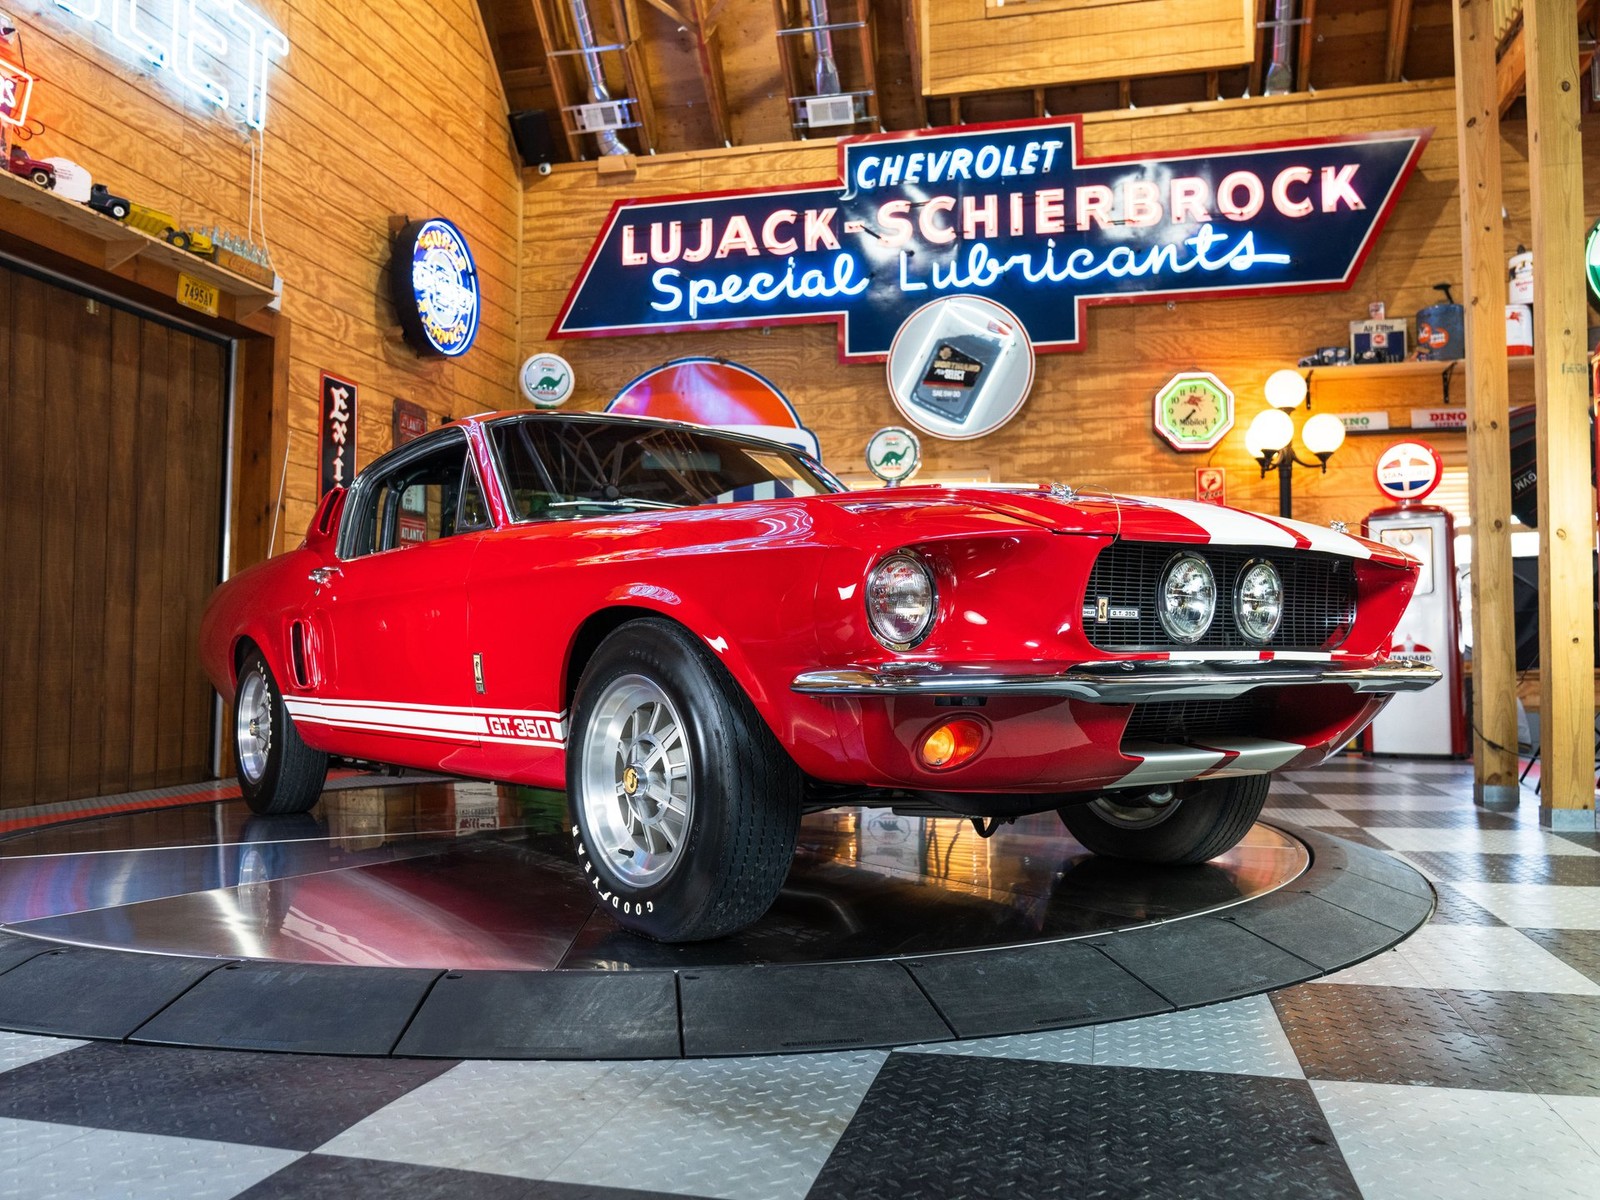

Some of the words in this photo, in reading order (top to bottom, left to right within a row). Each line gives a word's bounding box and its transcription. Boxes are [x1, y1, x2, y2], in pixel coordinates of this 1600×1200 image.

[856, 141, 1064, 189] CHEVROLET
[621, 163, 1367, 266] LUJACK-SCHIERBROCK
[650, 253, 870, 319] Special
[899, 223, 1291, 291] Lubricants
[329, 386, 350, 488] Exi
[1430, 412, 1467, 422] DINO
[401, 526, 425, 542] ATLANTIC
[513, 717, 551, 739] 350
